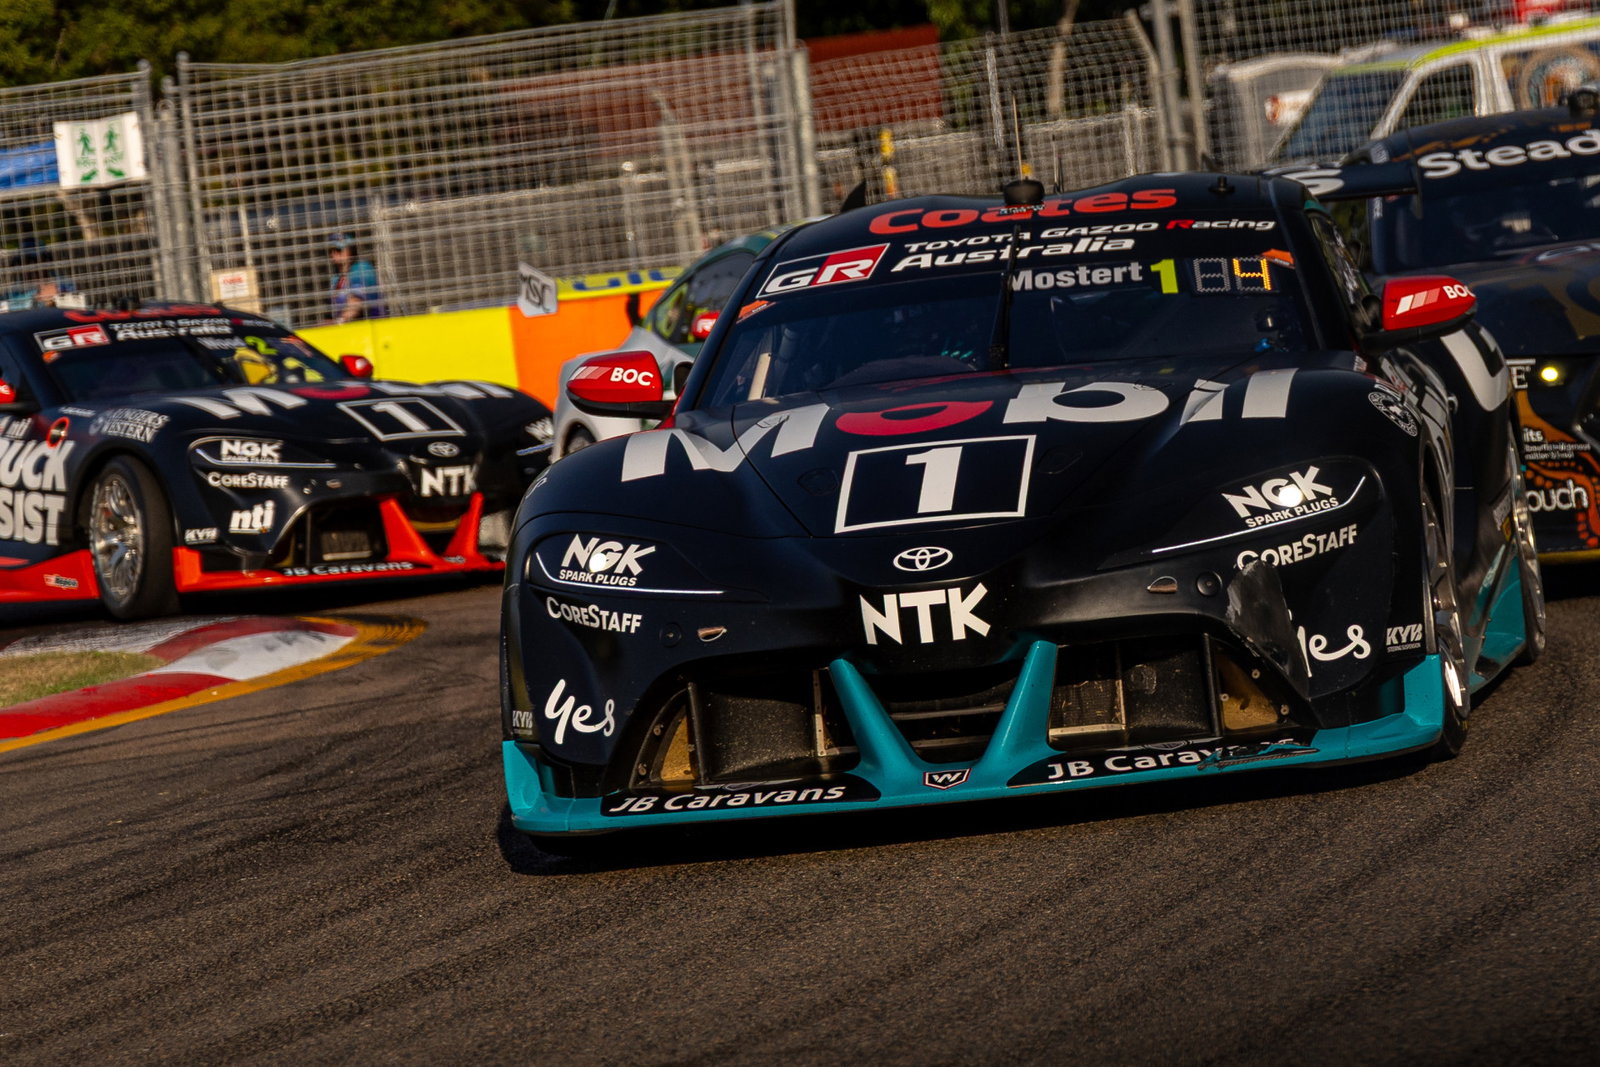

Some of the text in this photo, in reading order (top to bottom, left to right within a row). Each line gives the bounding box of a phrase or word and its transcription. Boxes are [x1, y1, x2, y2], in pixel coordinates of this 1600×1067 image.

[869, 188, 1178, 235] Coates
[904, 218, 1277, 253] TOYOTA GAZOO Racing
[891, 235, 1136, 273] Australia
[764, 261, 869, 294] GR
[1012, 258, 1179, 295] Mostert 1
[43, 331, 106, 349] GR
[609, 365, 655, 388] BOC
[372, 401, 432, 432] 1
[621, 368, 1298, 483] Mobil
[0, 437, 76, 492] UCK
[220, 439, 284, 458] NGK
[905, 446, 964, 515] 1
[1221, 465, 1333, 518] NGK
[1245, 497, 1339, 528] SPARK PLUGS
[561, 533, 656, 576] NGK
[559, 569, 638, 586] SPARK PLUGS
[859, 582, 991, 646] NTK
[1386, 623, 1423, 645] KYB
[512, 711, 534, 729] KYB
[1047, 760, 1095, 780] JB
[608, 785, 848, 814] JB Caravans
